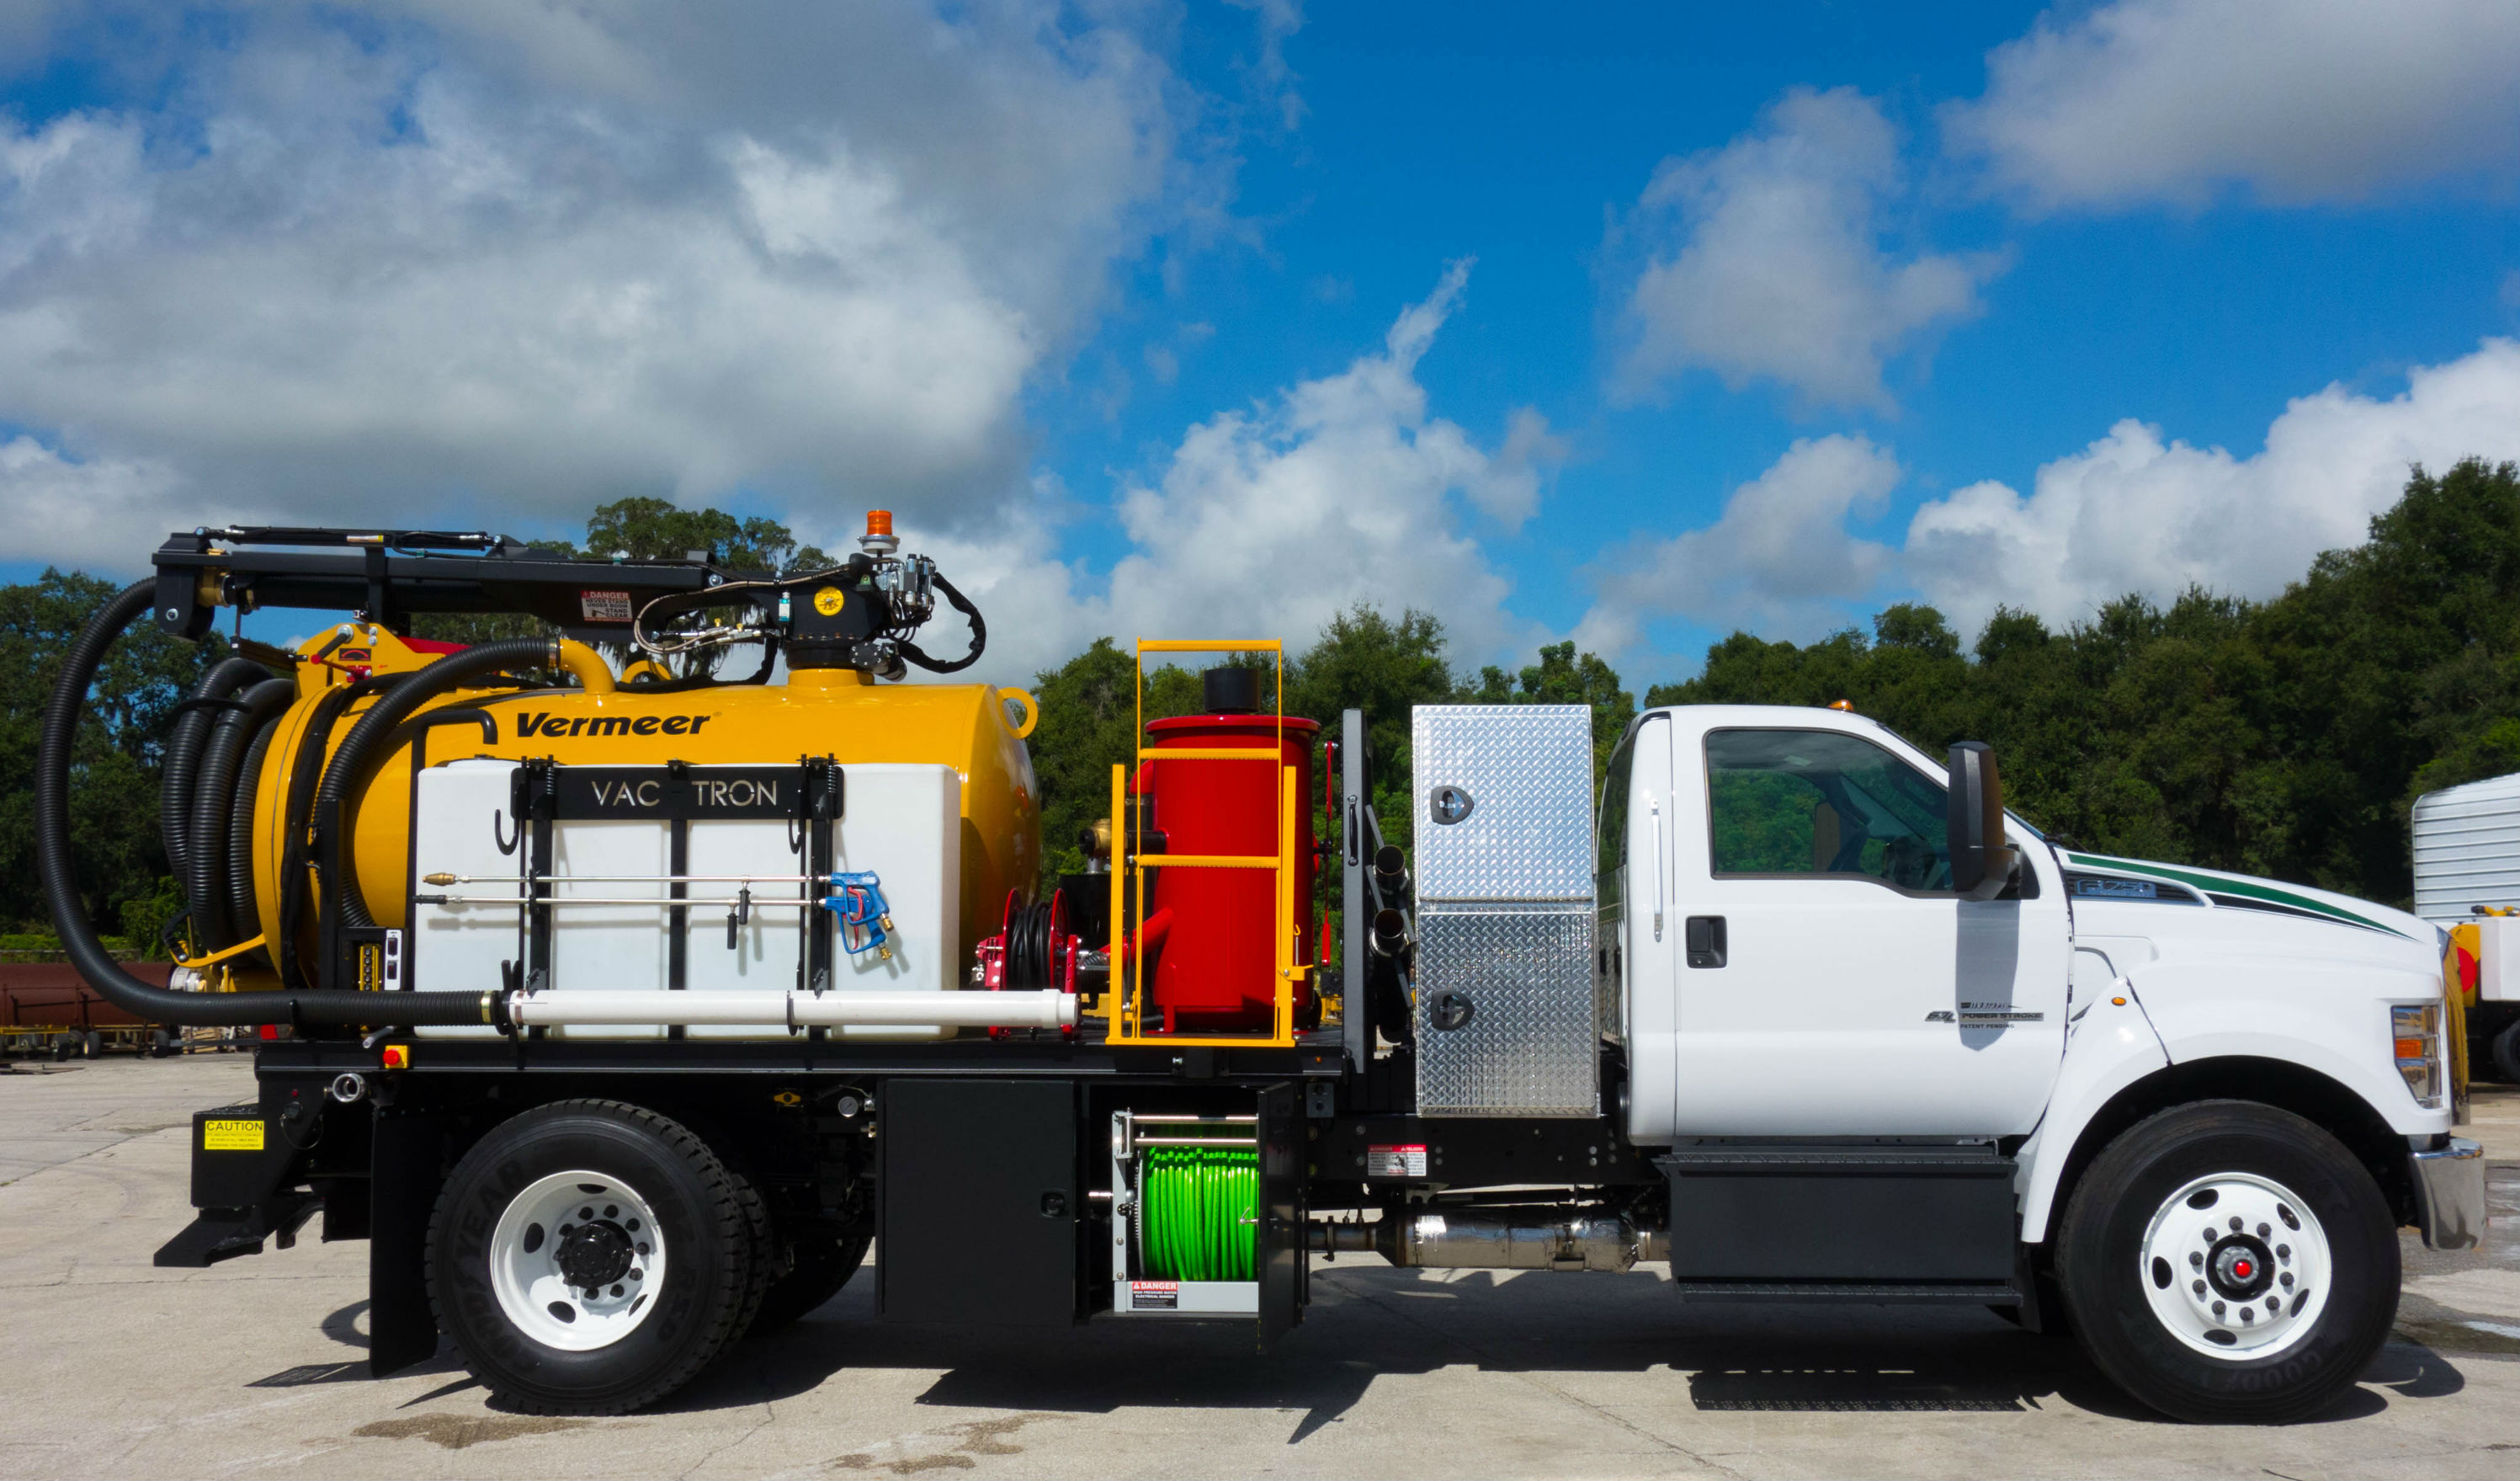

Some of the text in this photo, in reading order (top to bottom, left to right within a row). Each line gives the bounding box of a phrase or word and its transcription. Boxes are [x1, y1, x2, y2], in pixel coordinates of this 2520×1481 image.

[590, 591, 629, 599] DANGER
[517, 712, 711, 738] Vermeer
[591, 780, 777, 807] VAC TRON
[206, 1121, 263, 1132] CAUTION
[1140, 1281, 1177, 1290] DANGER
